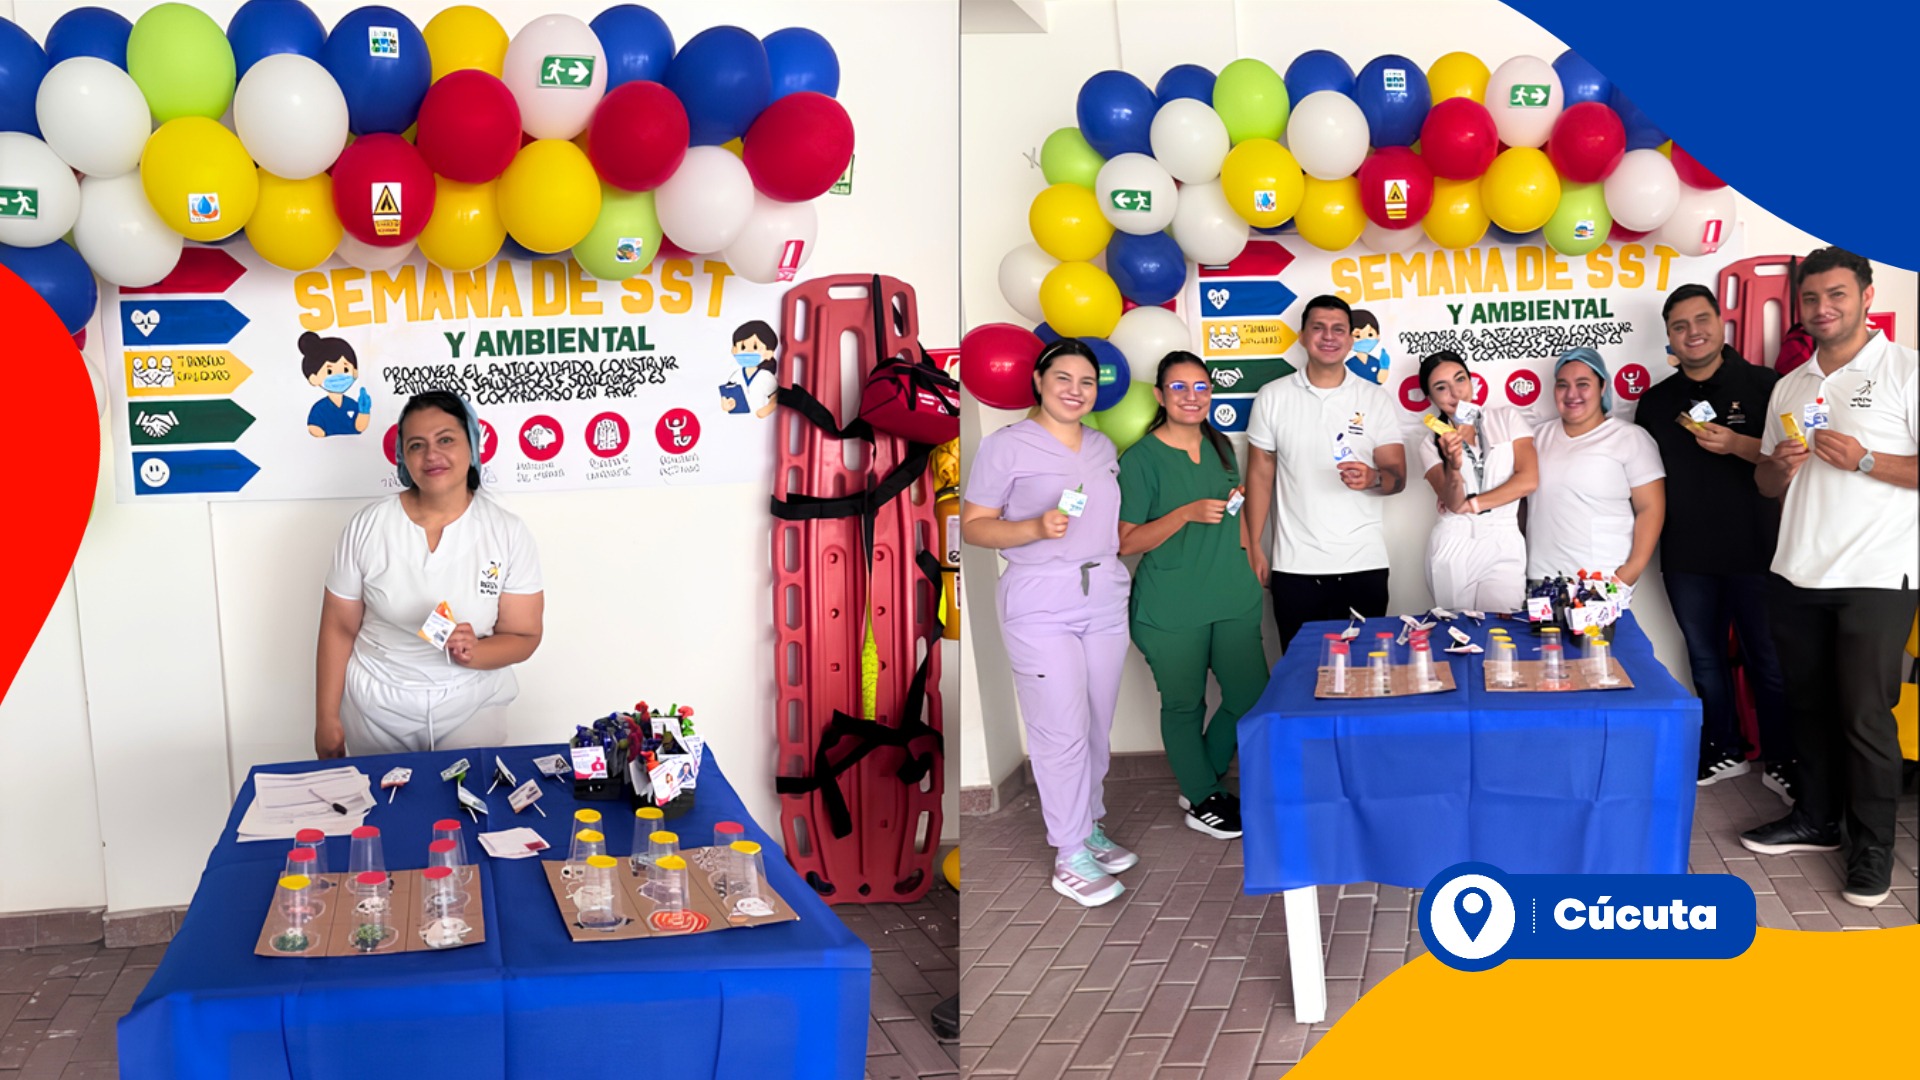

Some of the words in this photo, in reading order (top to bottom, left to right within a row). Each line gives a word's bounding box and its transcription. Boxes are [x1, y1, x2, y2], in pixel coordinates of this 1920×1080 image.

[294, 260, 523, 331] SEMANA
[532, 259, 603, 316] DE
[1331, 246, 1508, 306] SEMANA
[1516, 246, 1573, 291] DE
[1447, 303, 1464, 325] Y
[1470, 298, 1614, 324] AMBIENTAL
[444, 331, 466, 358] Y
[474, 325, 655, 357] AMBIENTAL
